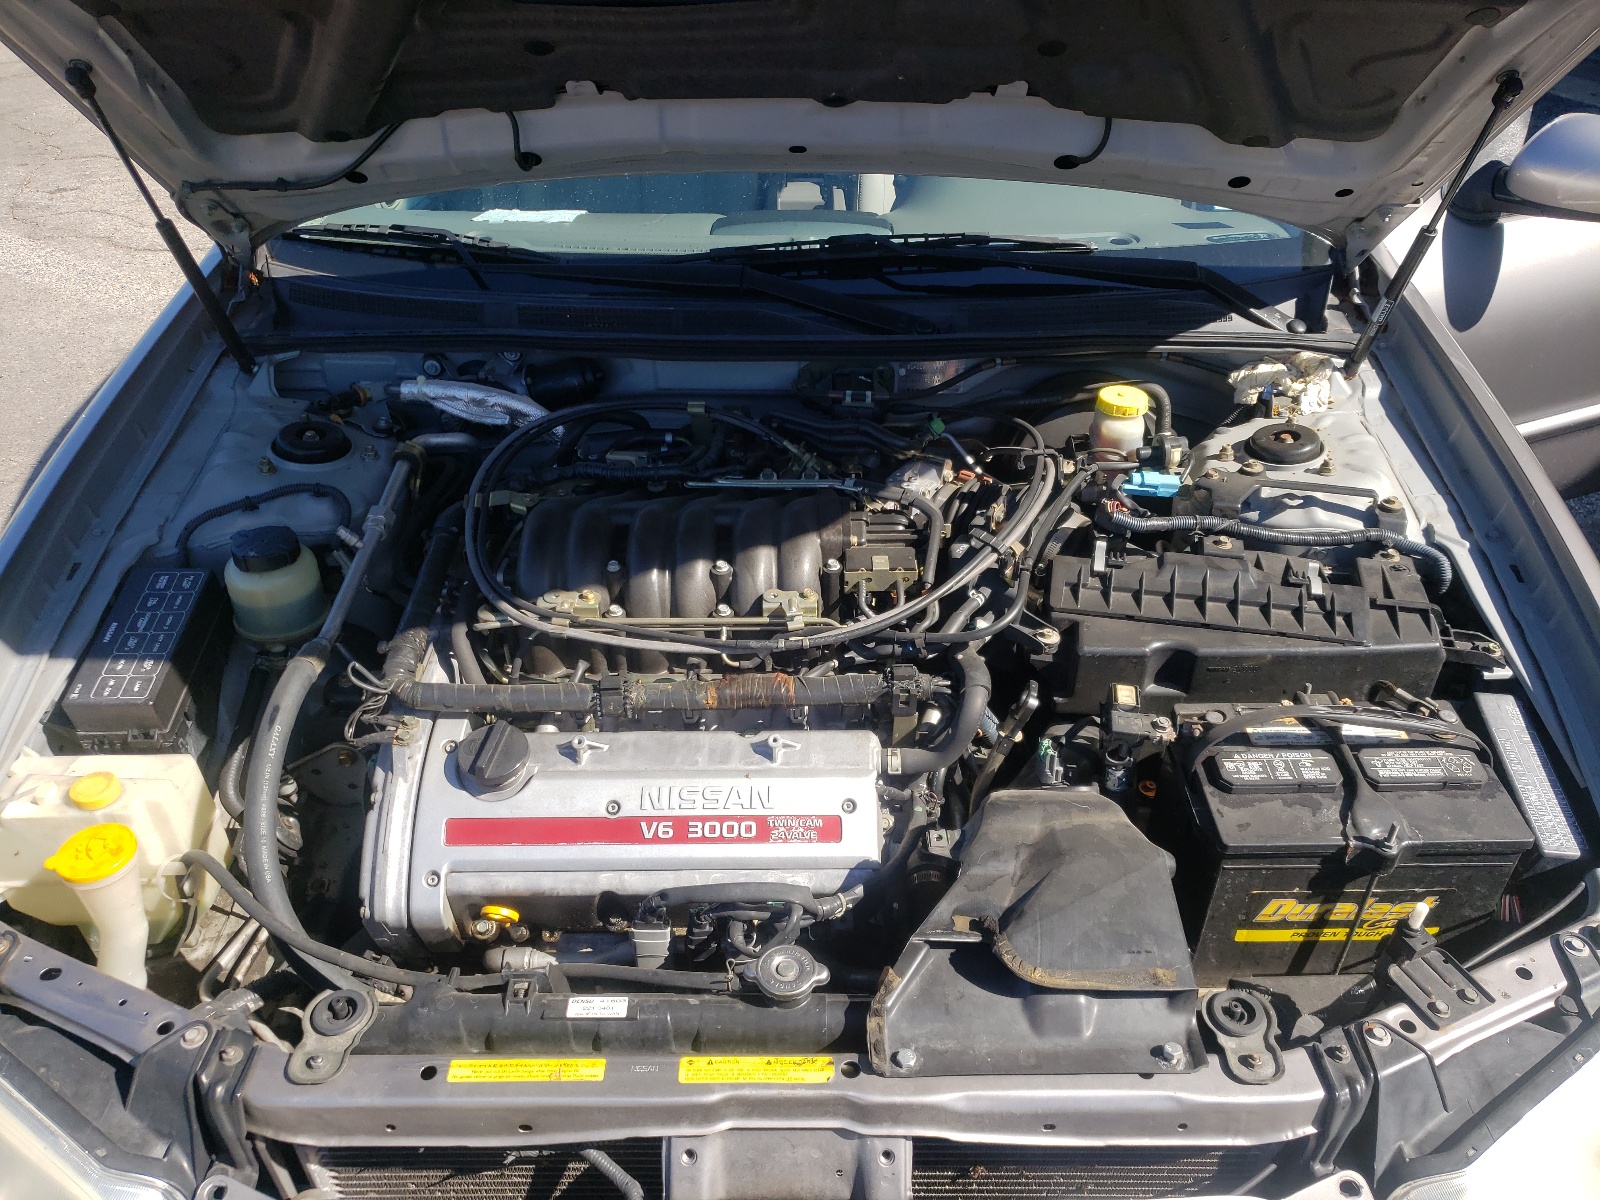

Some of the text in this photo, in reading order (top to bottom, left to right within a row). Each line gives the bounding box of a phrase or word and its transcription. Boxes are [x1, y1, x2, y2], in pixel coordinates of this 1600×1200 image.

[269, 725, 282, 760] GALAXY
[640, 785, 774, 810] NISSAN
[640, 821, 757, 838] V6 3000
[768, 819, 822, 827] TWIN CAM
[771, 831, 818, 840] 24VALVE
[261, 845, 269, 863] MADE
[264, 870, 273, 884] USA
